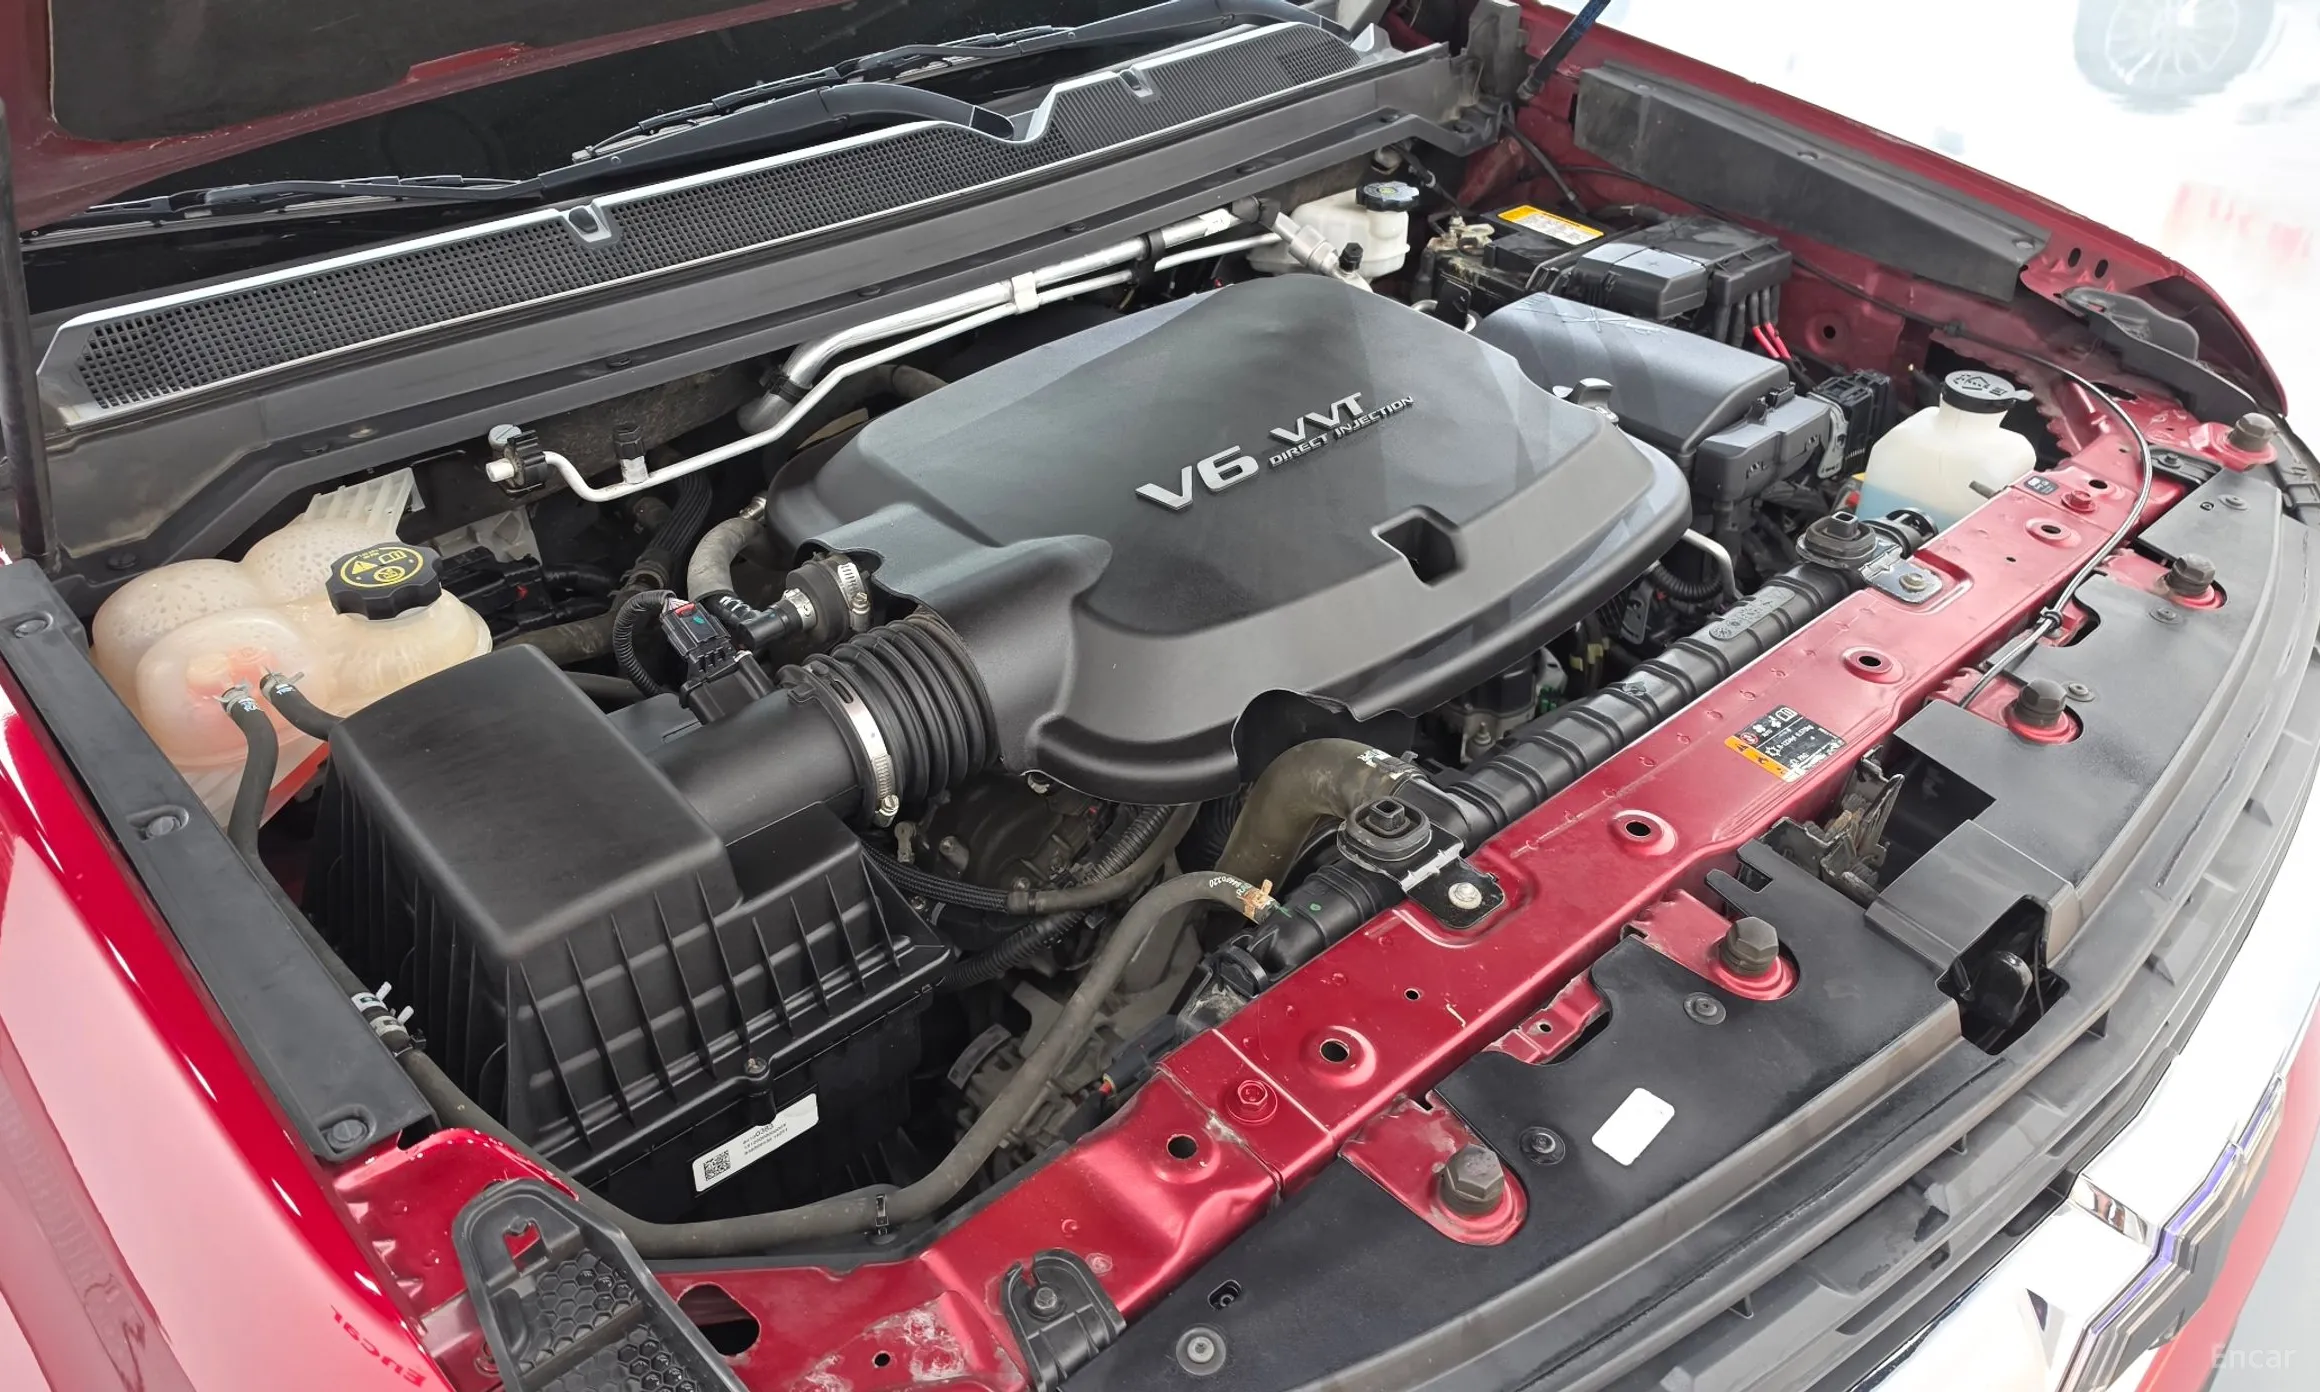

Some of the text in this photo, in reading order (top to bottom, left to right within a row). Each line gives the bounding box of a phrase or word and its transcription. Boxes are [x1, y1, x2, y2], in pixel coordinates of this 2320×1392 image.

[1268, 392, 1364, 443] VVT
[1268, 395, 1414, 467] DIRECT INJECTION
[1135, 445, 1259, 511] V6
